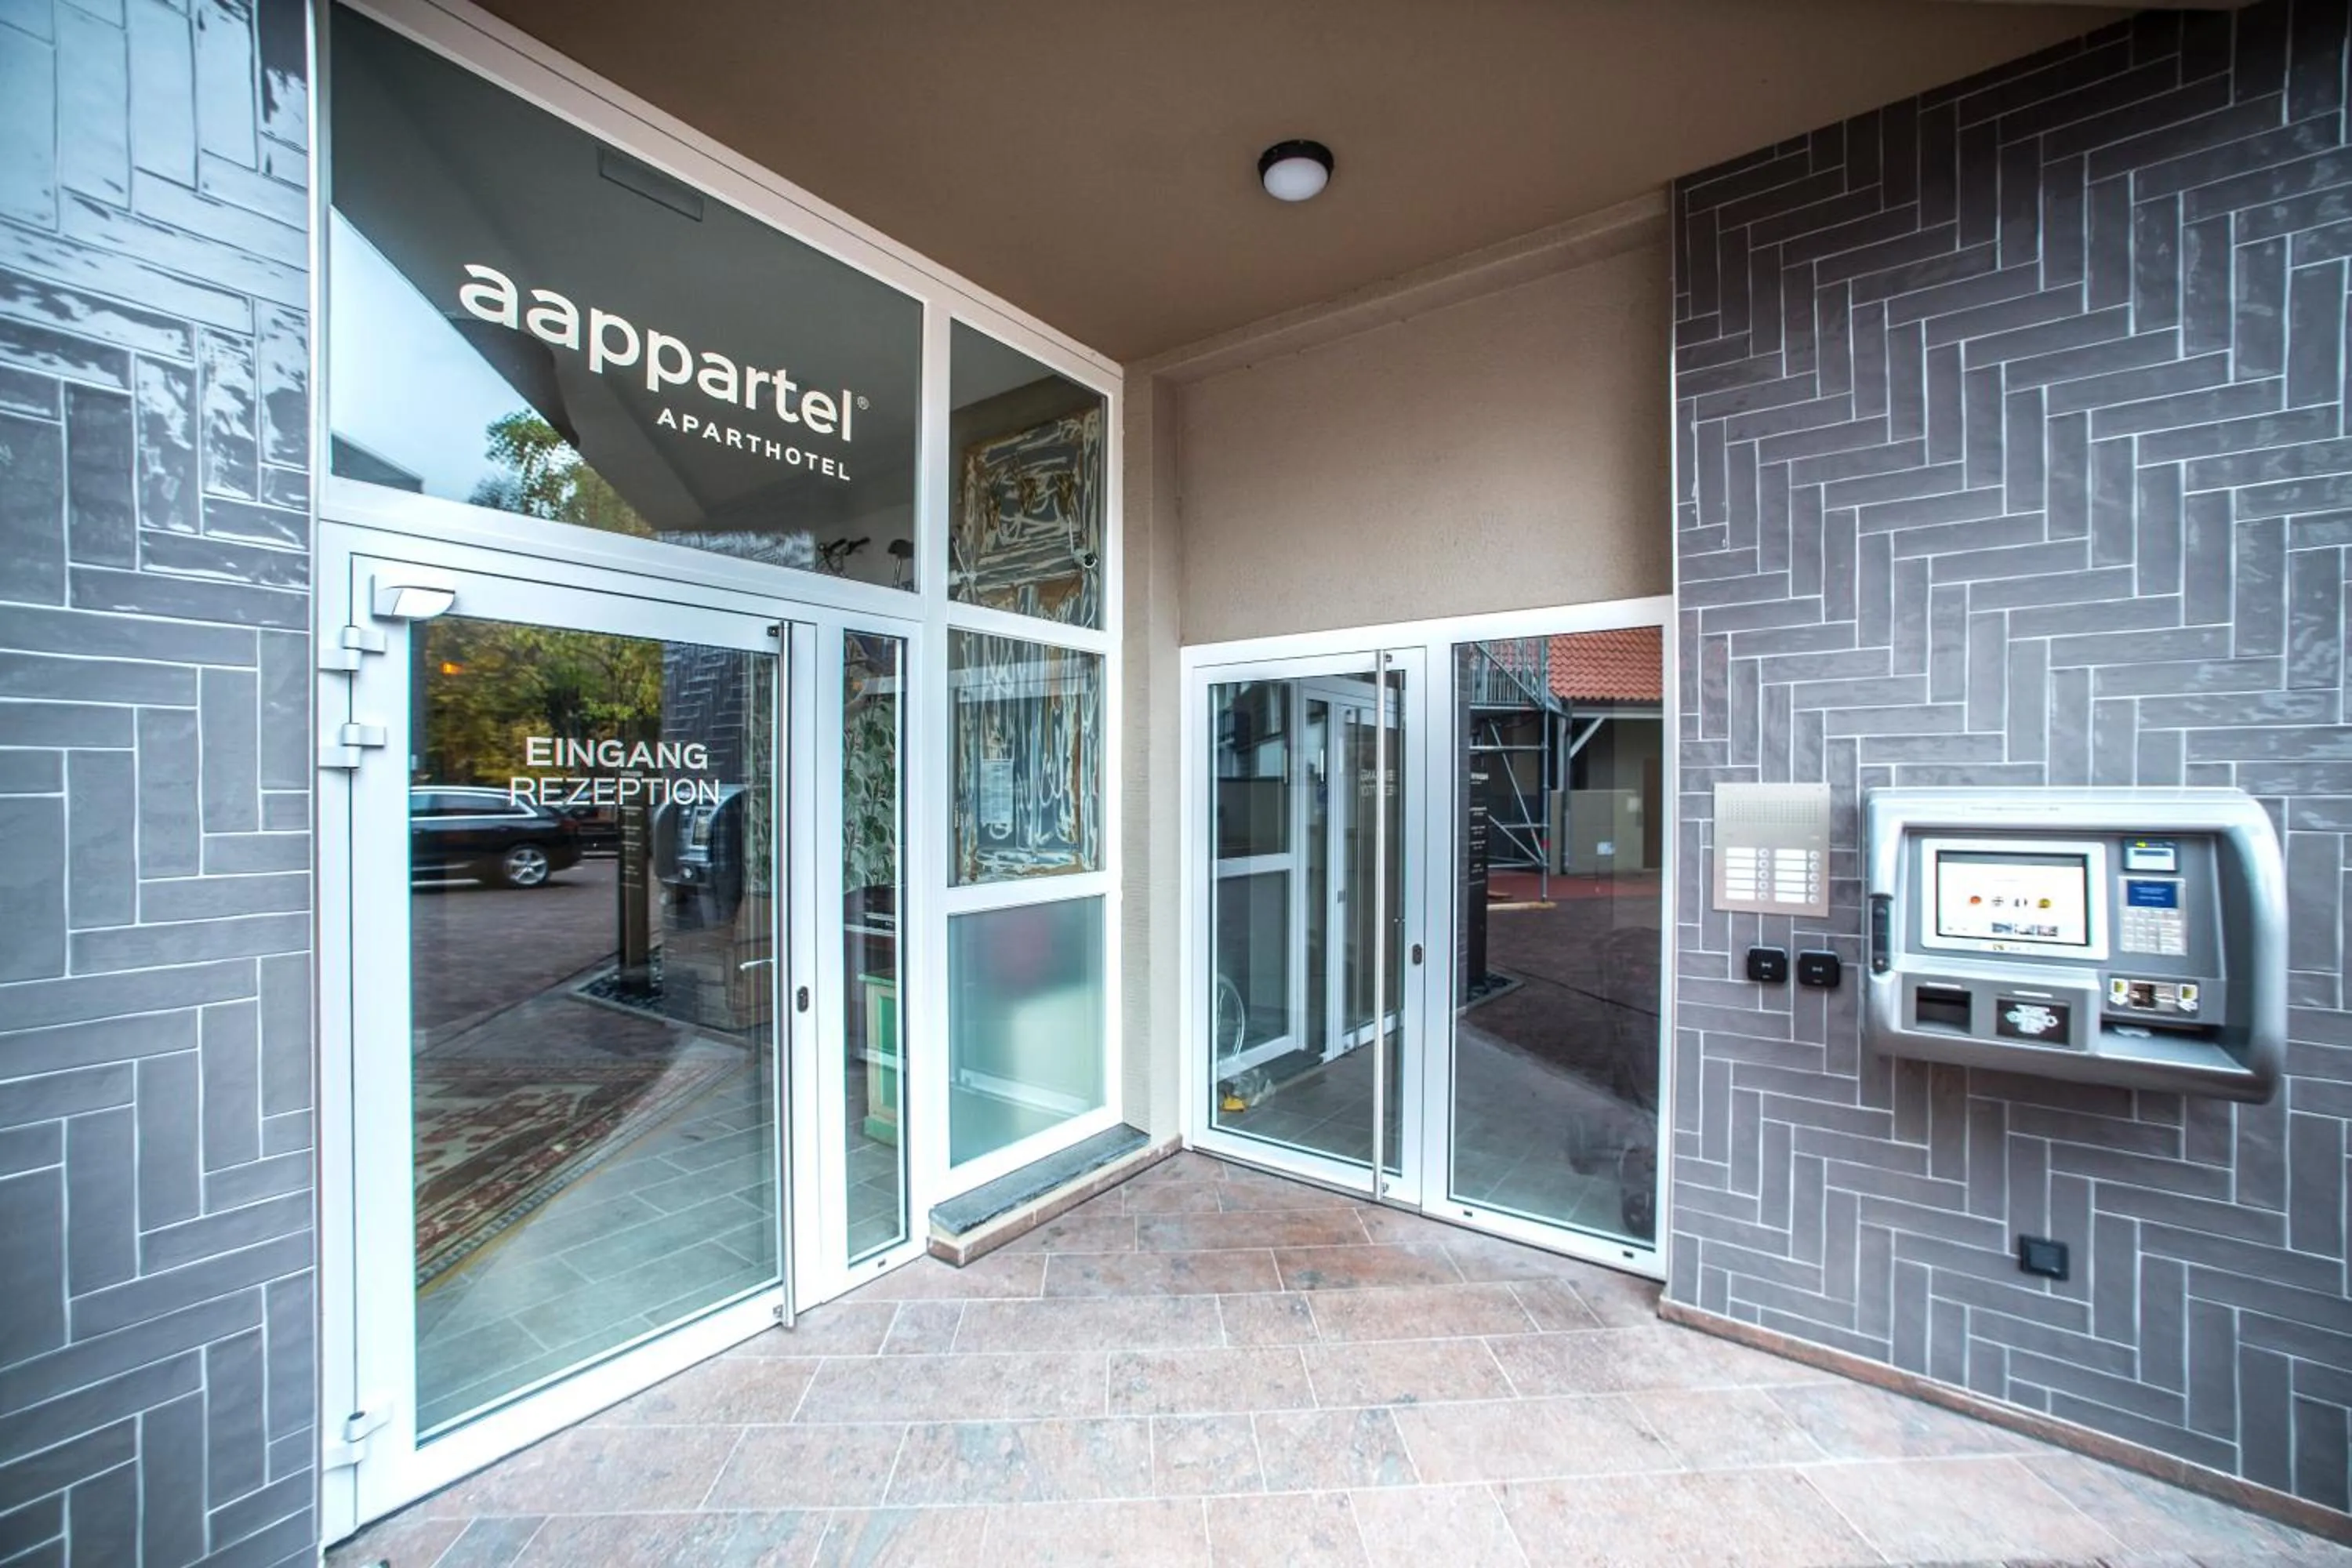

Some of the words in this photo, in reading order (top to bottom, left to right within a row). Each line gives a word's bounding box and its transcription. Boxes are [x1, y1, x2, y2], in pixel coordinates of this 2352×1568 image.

[656, 408, 851, 481] APARTHOTEL
[525, 736, 709, 770] EINGANG
[510, 776, 720, 806] REZEPTION
